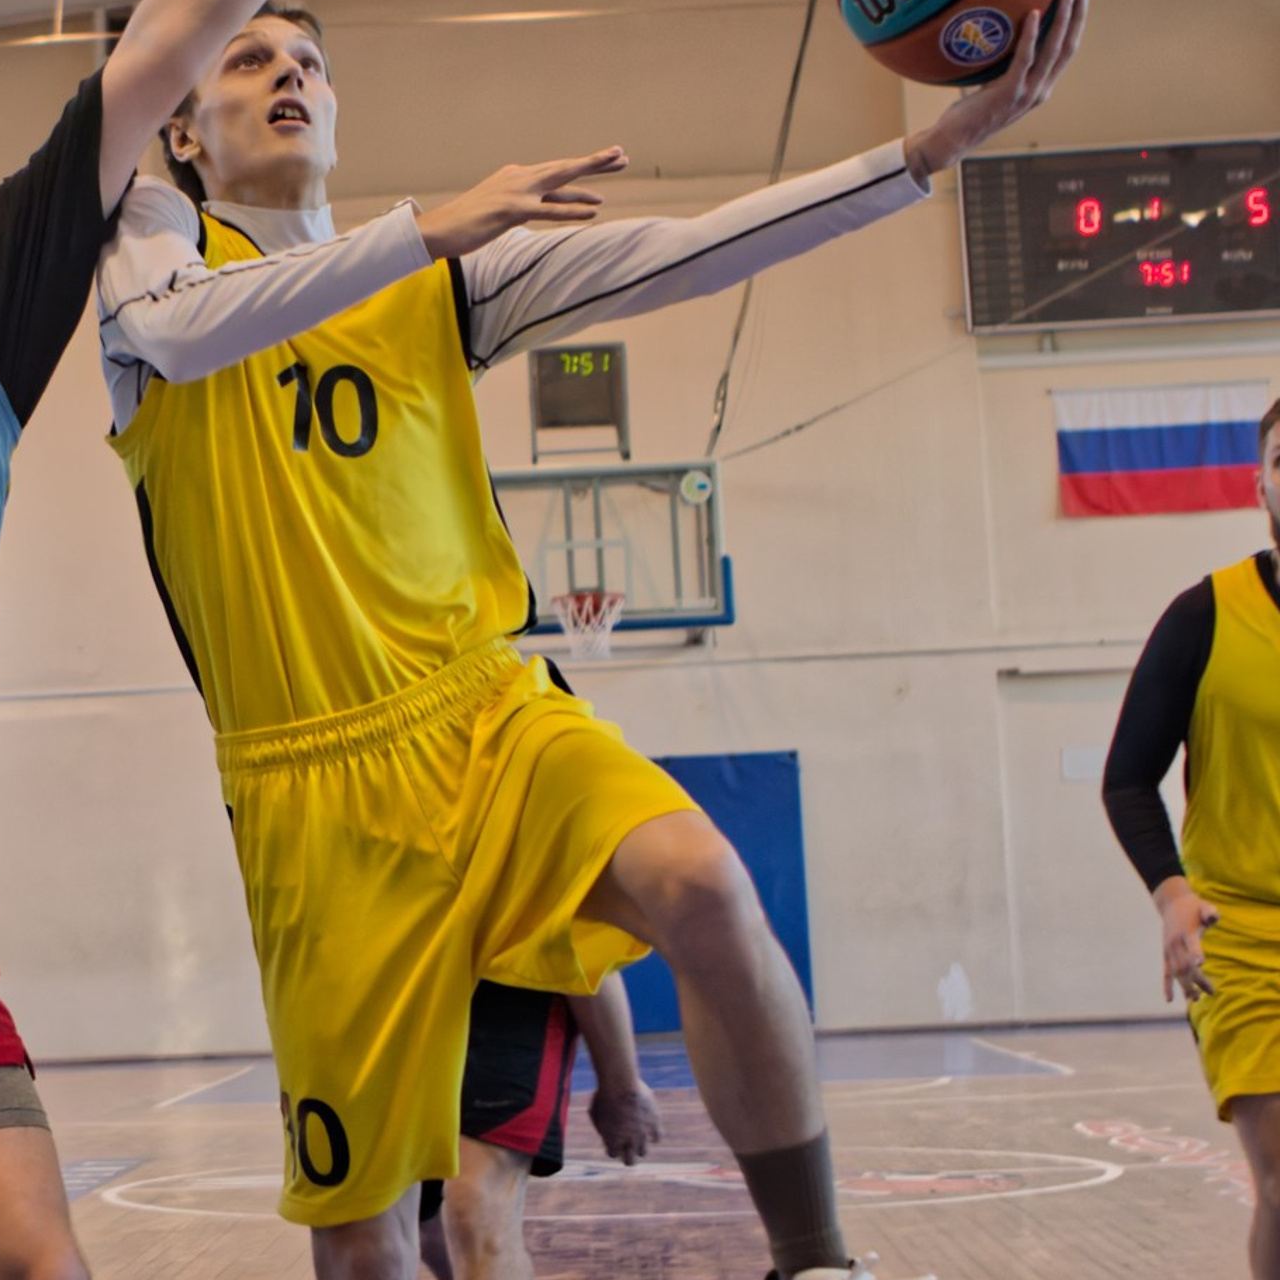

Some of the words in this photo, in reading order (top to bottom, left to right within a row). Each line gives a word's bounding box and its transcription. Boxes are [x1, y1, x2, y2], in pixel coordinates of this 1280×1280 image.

[1077, 197, 1102, 237] 0
[1245, 187, 1270, 227] 5
[1138, 260, 1191, 288] 7:51
[560, 352, 611, 376] 7:51
[276, 361, 379, 458] 10
